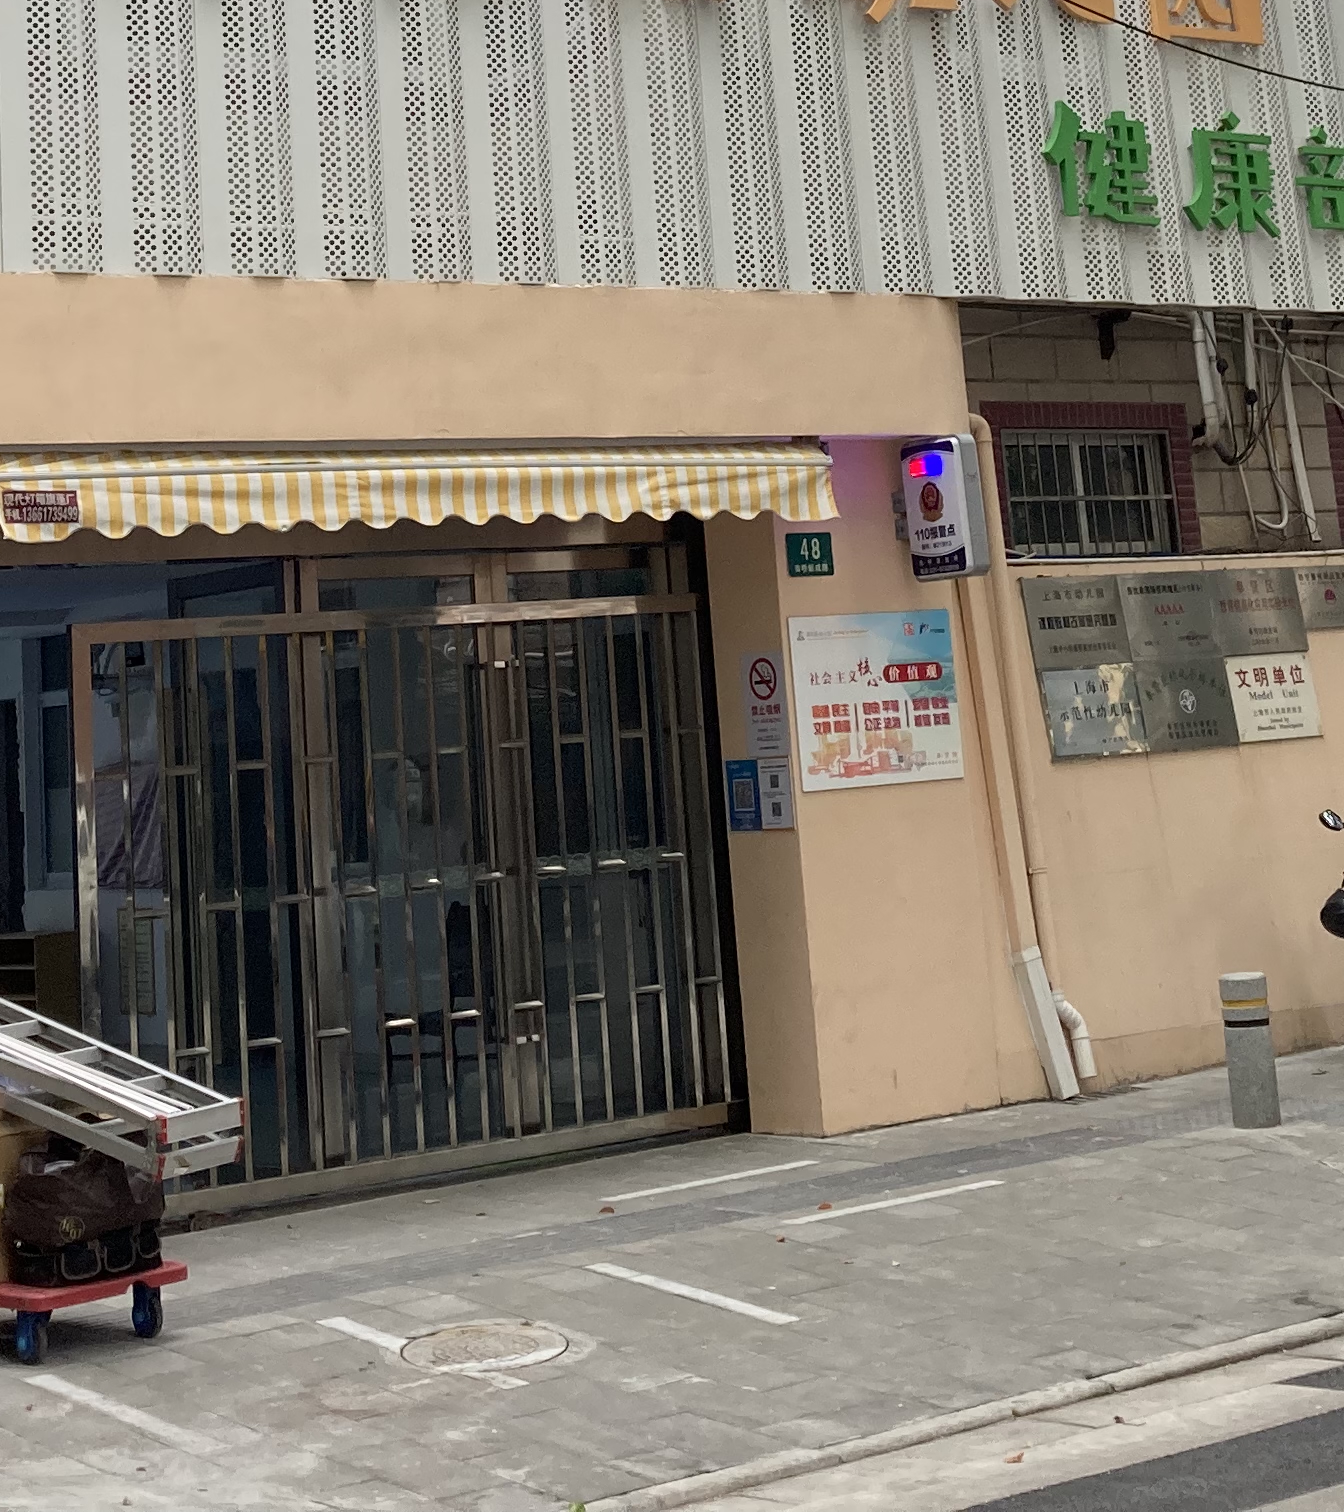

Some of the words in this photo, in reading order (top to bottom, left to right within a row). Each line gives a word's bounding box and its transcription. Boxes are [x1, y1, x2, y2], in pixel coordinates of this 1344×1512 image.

[800, 537, 821, 560] 48
[1234, 665, 1305, 688] 文明单位
[1073, 679, 1110, 696] 上海市
[1248, 690, 1273, 700] Model
[1060, 703, 1131, 721] 示范性幼儿园
